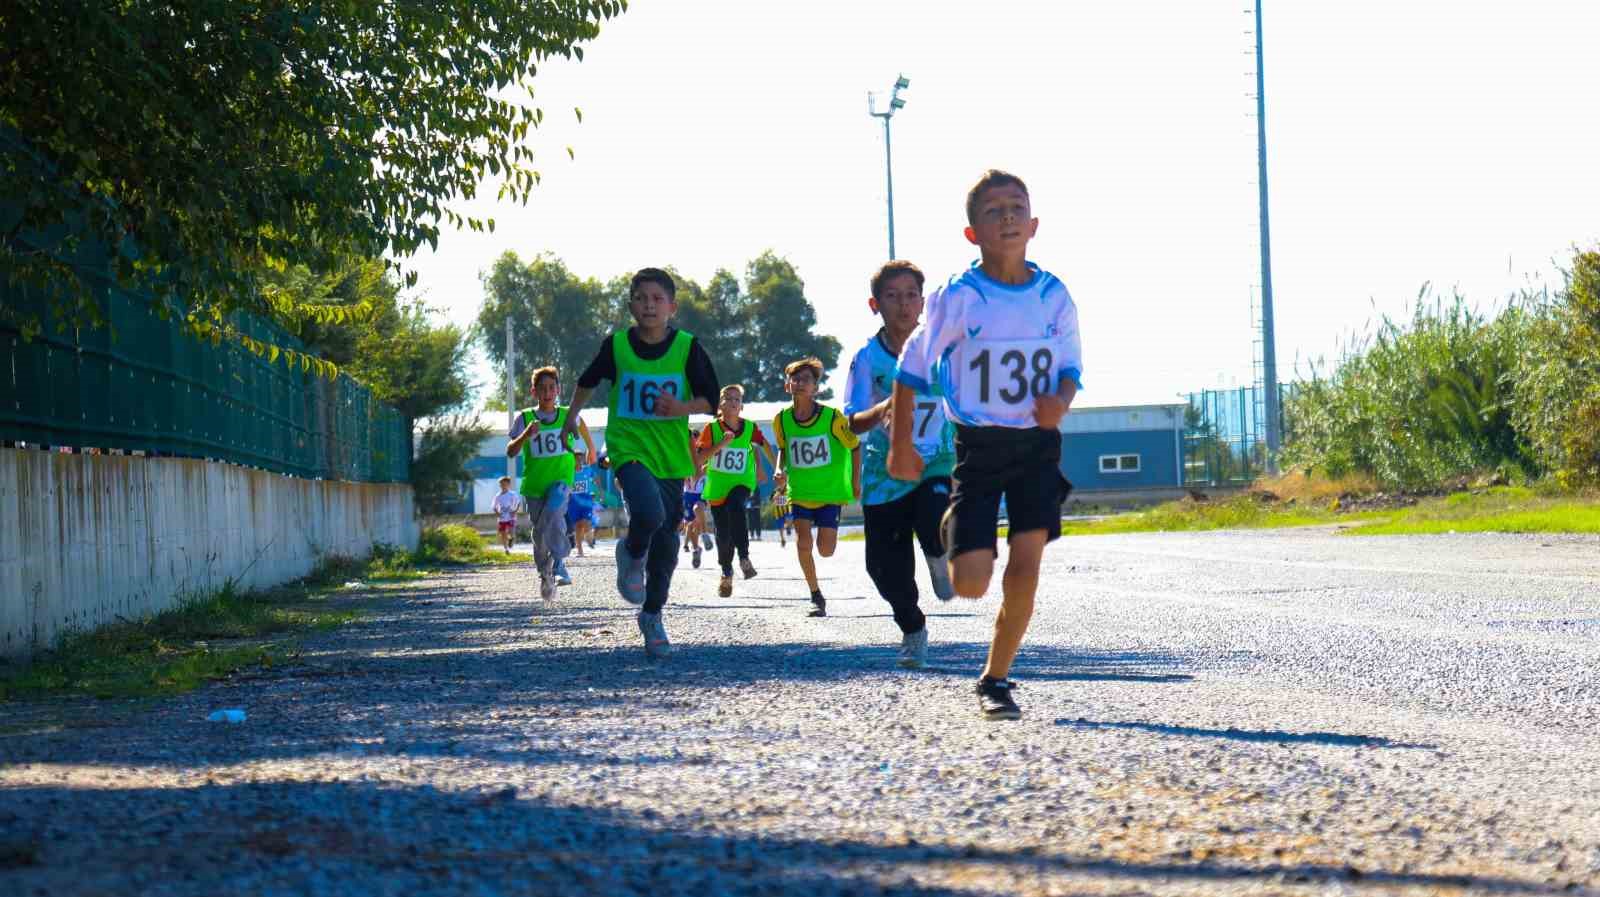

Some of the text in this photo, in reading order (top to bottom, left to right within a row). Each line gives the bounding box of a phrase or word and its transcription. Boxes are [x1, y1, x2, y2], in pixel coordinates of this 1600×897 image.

[969, 348, 1053, 404] 138
[715, 450, 744, 470] 163
[791, 438, 829, 464] 164
